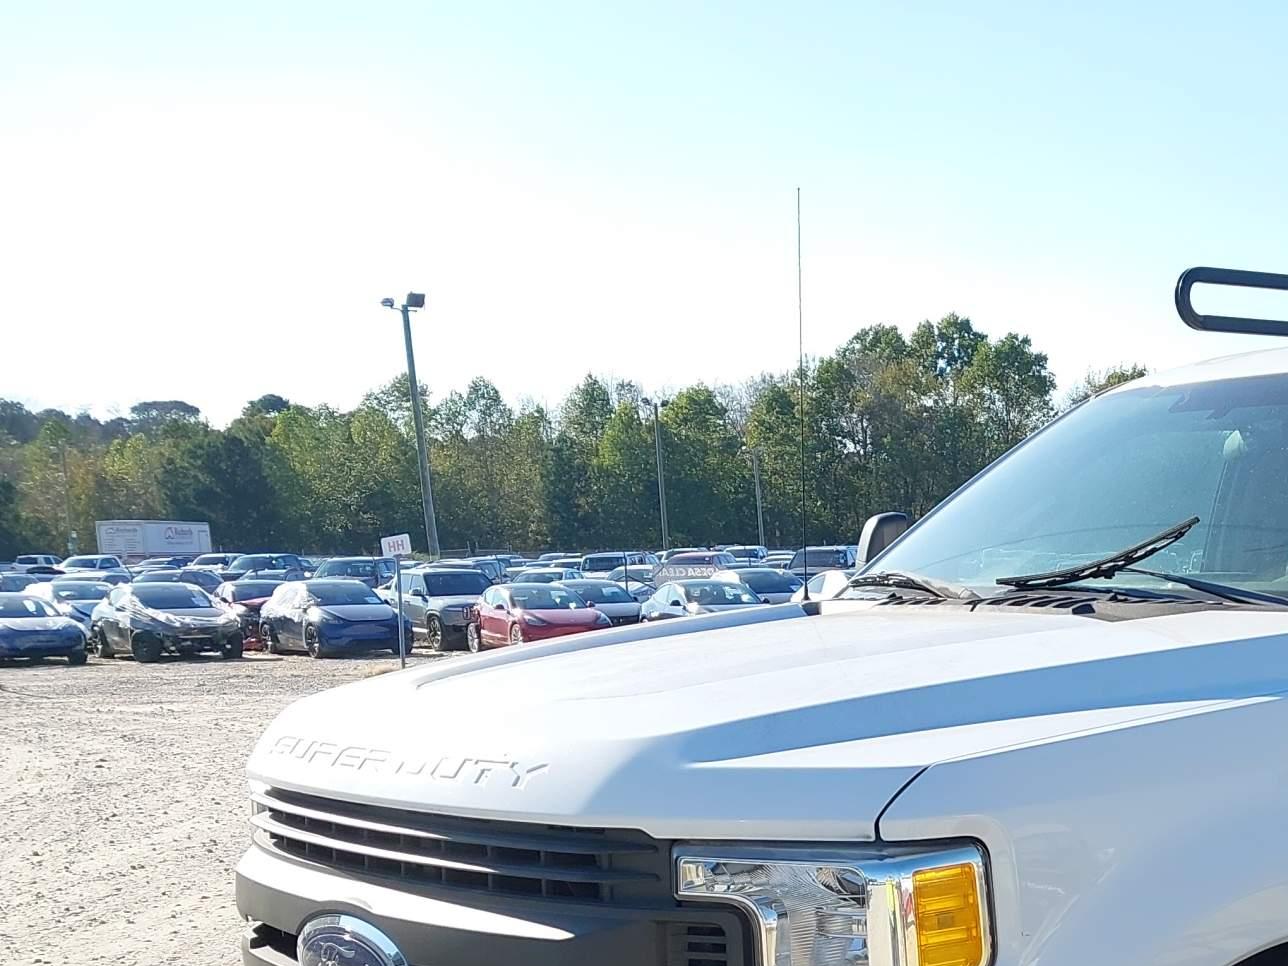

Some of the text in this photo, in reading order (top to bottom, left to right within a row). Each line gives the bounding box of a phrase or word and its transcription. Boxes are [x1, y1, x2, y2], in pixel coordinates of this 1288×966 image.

[387, 540, 405, 552] HH
[270, 735, 550, 790] SUPER DUTY
